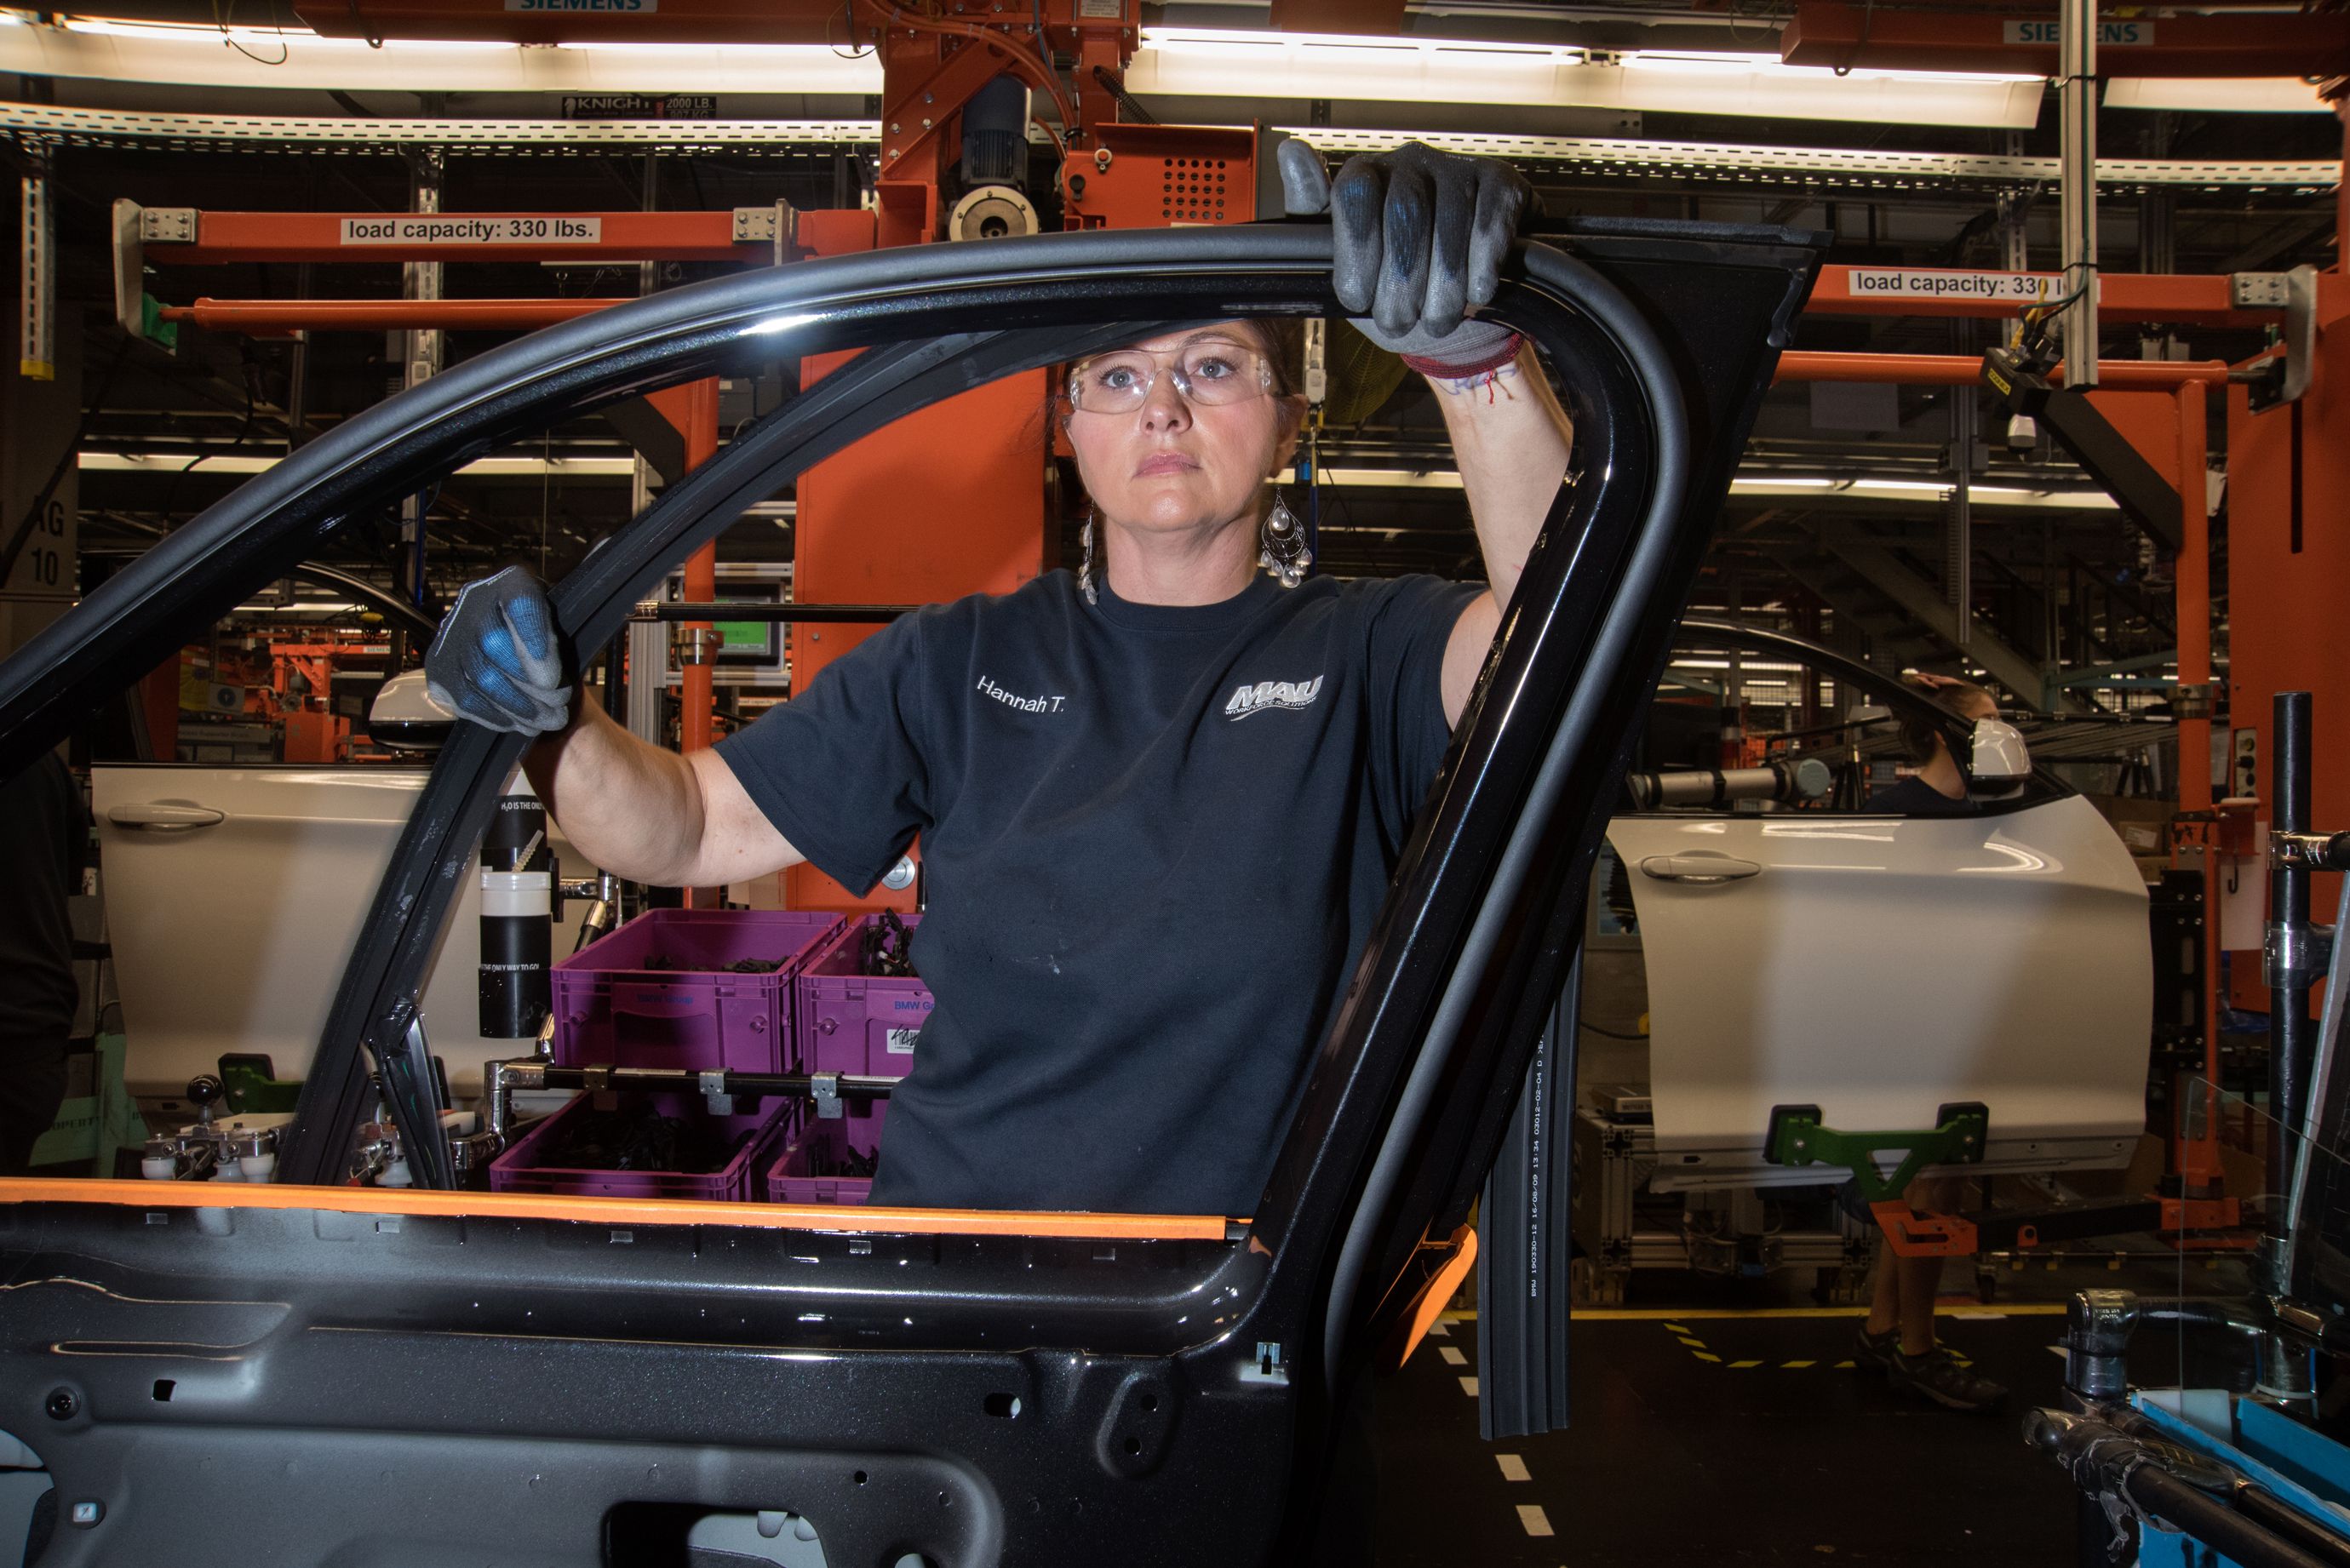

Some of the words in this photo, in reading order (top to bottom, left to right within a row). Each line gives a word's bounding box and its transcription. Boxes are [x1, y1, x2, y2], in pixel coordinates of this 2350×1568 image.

[2019, 22, 2139, 43] SIENS
[668, 97, 692, 109] 2000
[694, 97, 713, 109] LB.
[349, 220, 396, 239] load
[403, 220, 502, 242] capacity:
[509, 220, 547, 238] 330
[554, 220, 593, 238] lbs.
[1857, 272, 1902, 290] load
[1909, 275, 2005, 296] capacity:
[32, 547, 58, 586] 10
[977, 675, 1047, 713] Hannah
[1051, 695, 1066, 712] T.
[1226, 674, 1324, 710] MAU
[1224, 699, 1275, 716] WORKFORCE
[513, 802, 519, 810] IS
[519, 802, 531, 810] THE
[894, 1001, 920, 1010] BMW
[1533, 1072, 1542, 1136] 03012-02-04
